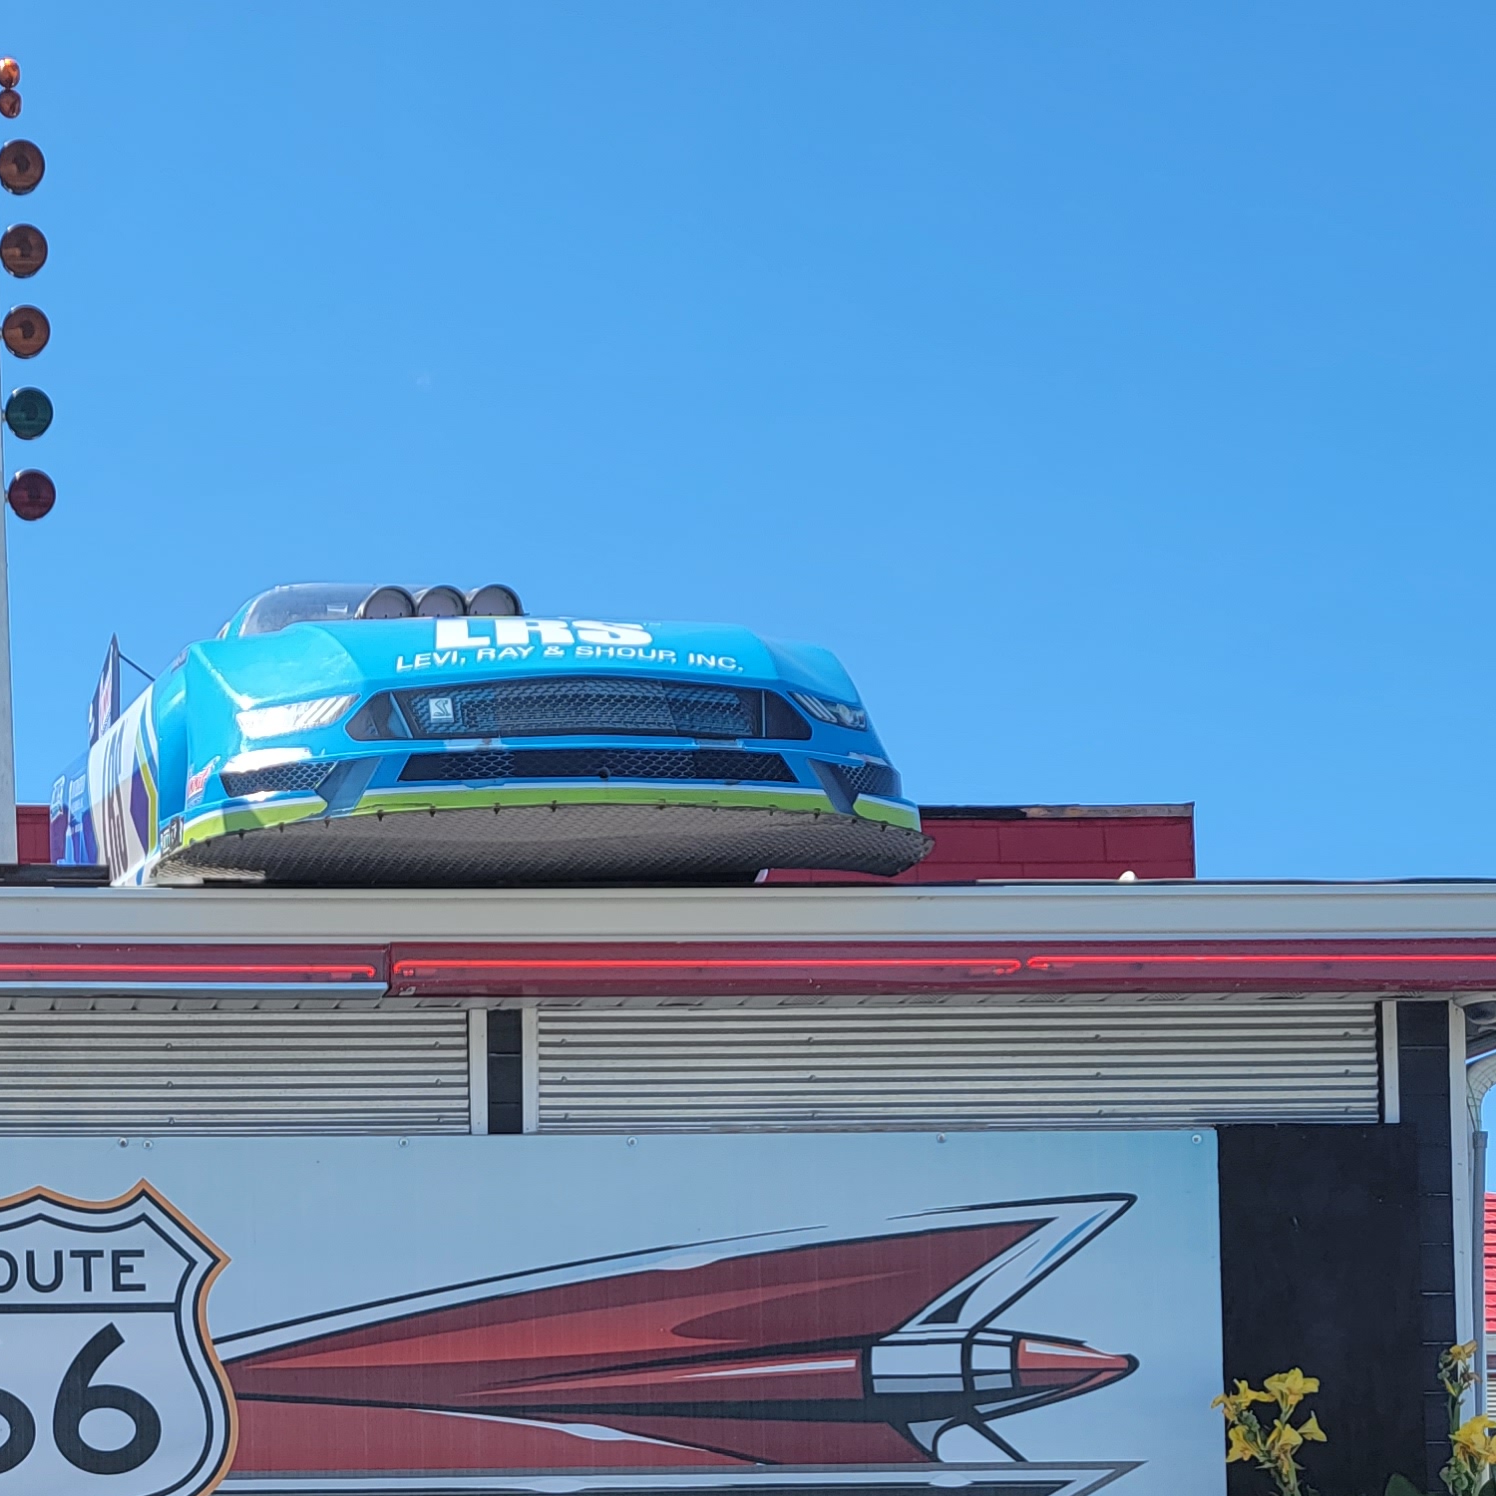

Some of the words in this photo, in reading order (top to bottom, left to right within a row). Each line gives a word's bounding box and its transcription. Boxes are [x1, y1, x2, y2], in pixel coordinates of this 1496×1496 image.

[435, 616, 654, 649] LRS
[396, 651, 466, 673] LEVI,
[475, 646, 536, 661] RAY
[542, 645, 566, 658] &
[574, 645, 678, 663] SHOUP,
[688, 652, 745, 673] INC.
